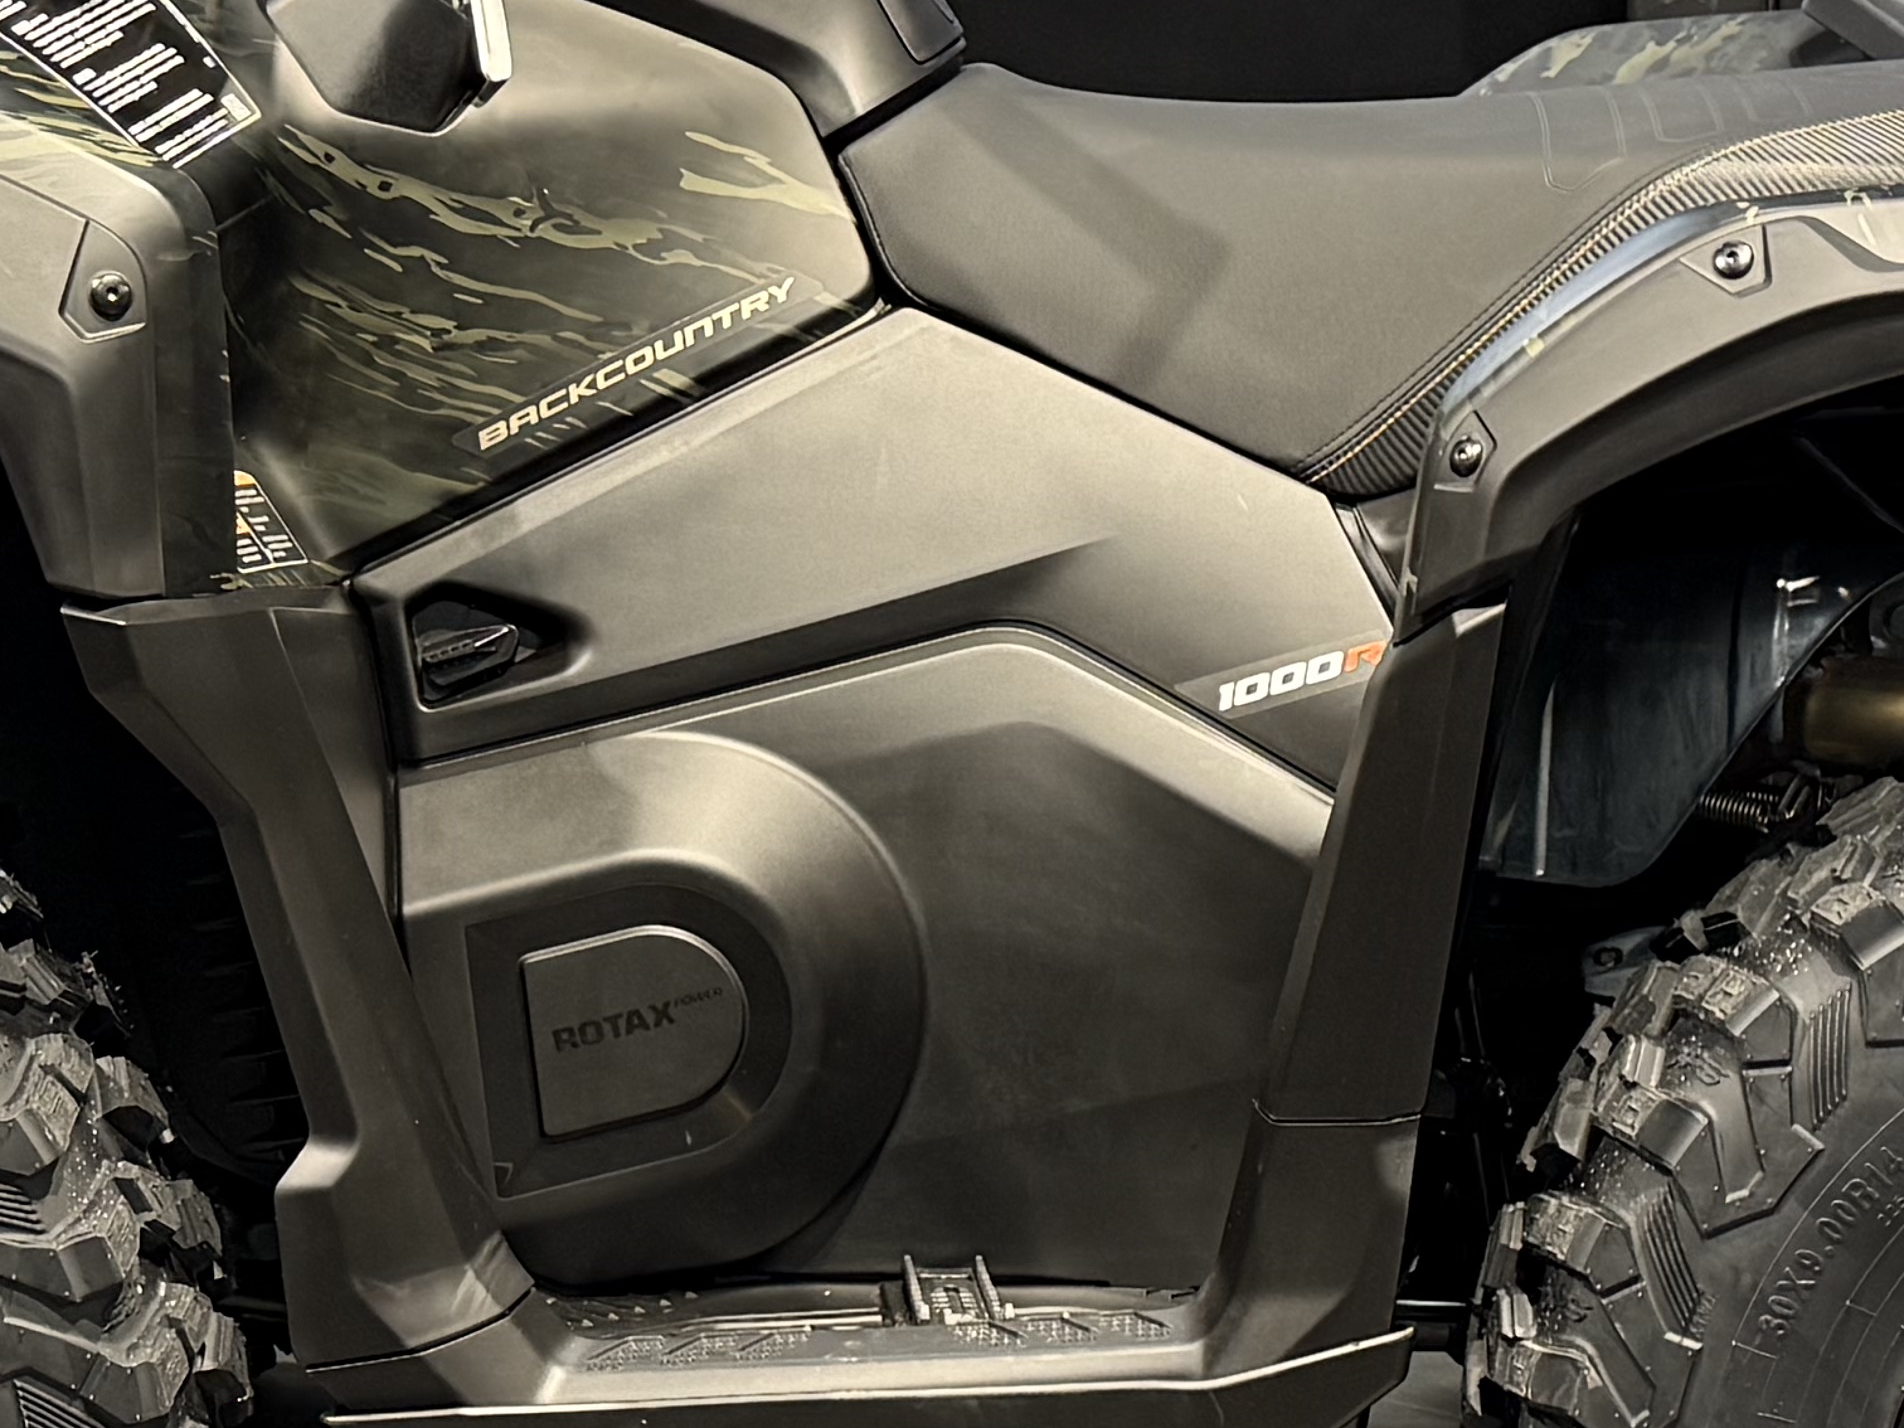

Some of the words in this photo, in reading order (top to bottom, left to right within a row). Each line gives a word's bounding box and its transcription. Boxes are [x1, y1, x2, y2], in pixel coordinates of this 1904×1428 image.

[477, 276, 797, 451] BACKCOUNTRY
[1218, 639, 1386, 712] 1000R
[551, 1000, 676, 1053] ROTAX
